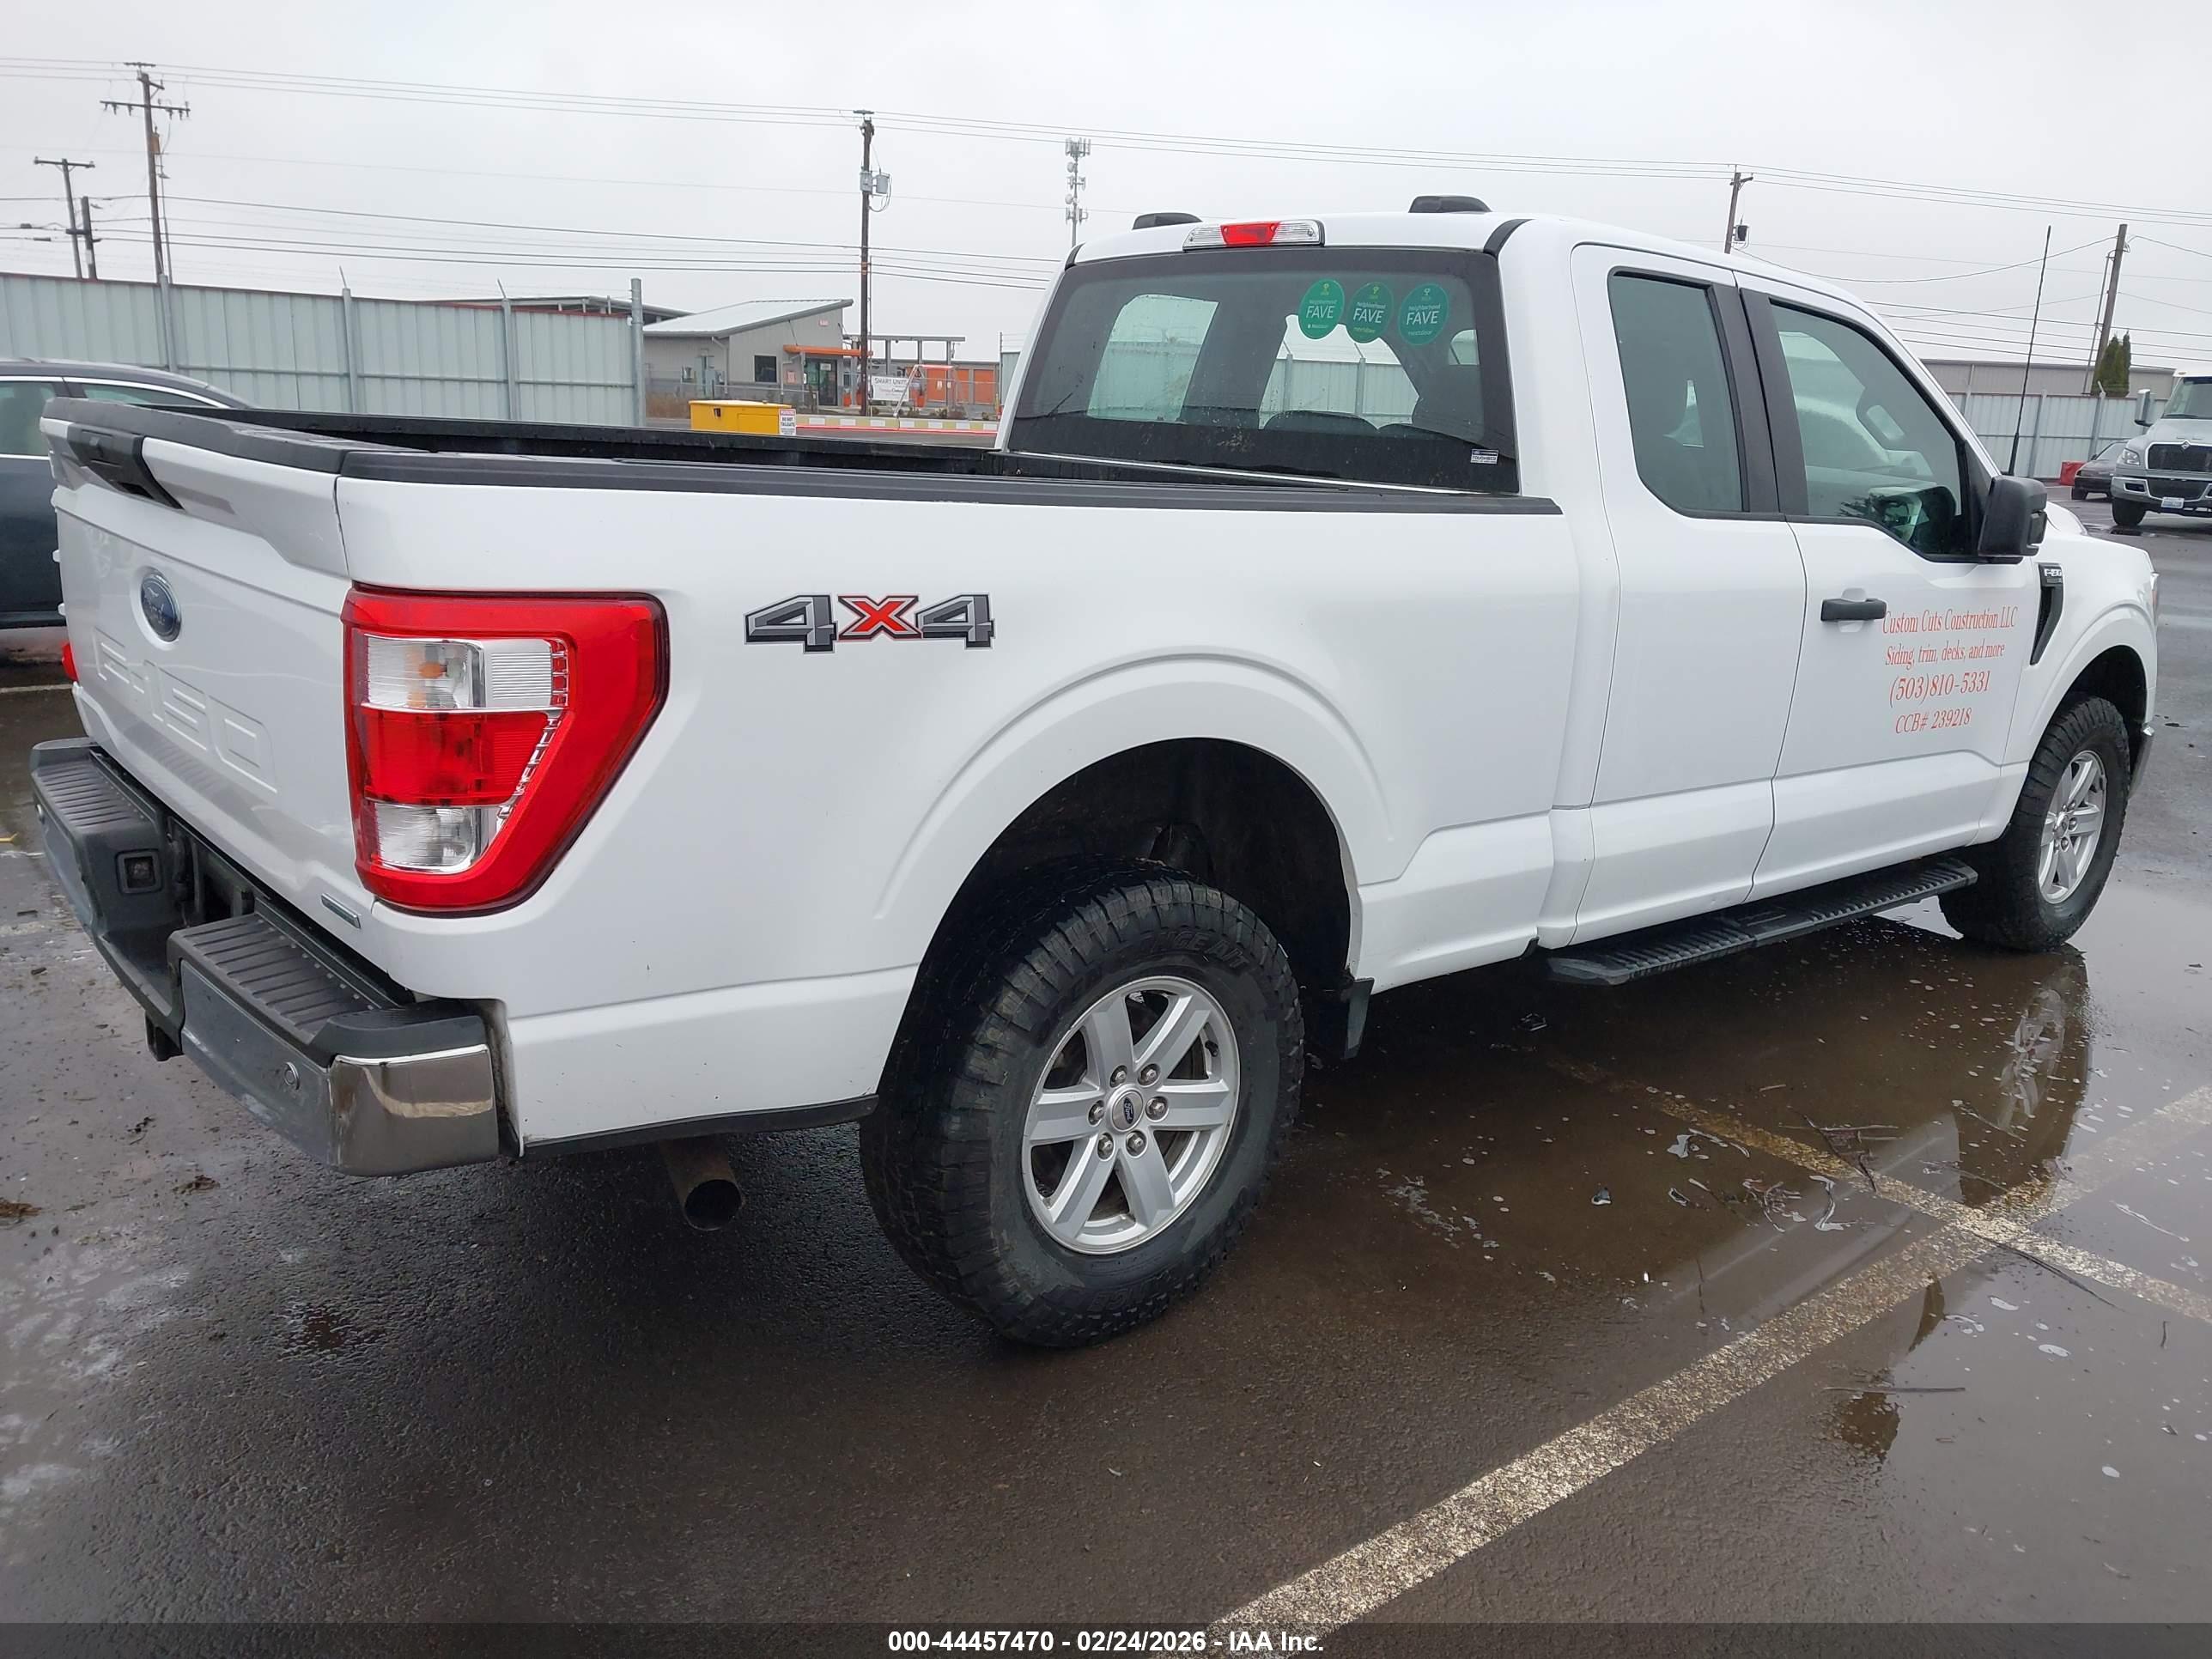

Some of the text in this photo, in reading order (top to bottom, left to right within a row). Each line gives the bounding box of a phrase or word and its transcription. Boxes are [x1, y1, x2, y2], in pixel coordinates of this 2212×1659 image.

[1305, 305, 1335, 319] FAVE
[1352, 307, 1384, 324] FAVE
[1406, 310, 1440, 325] FAVE
[1882, 605, 2019, 634] Custom Cuts Construction LLC
[1885, 638, 2006, 671] Siding, trim, decks, and more
[1889, 670, 1991, 708] (503)810-5331
[1895, 707, 1972, 734] CCB# 239218
